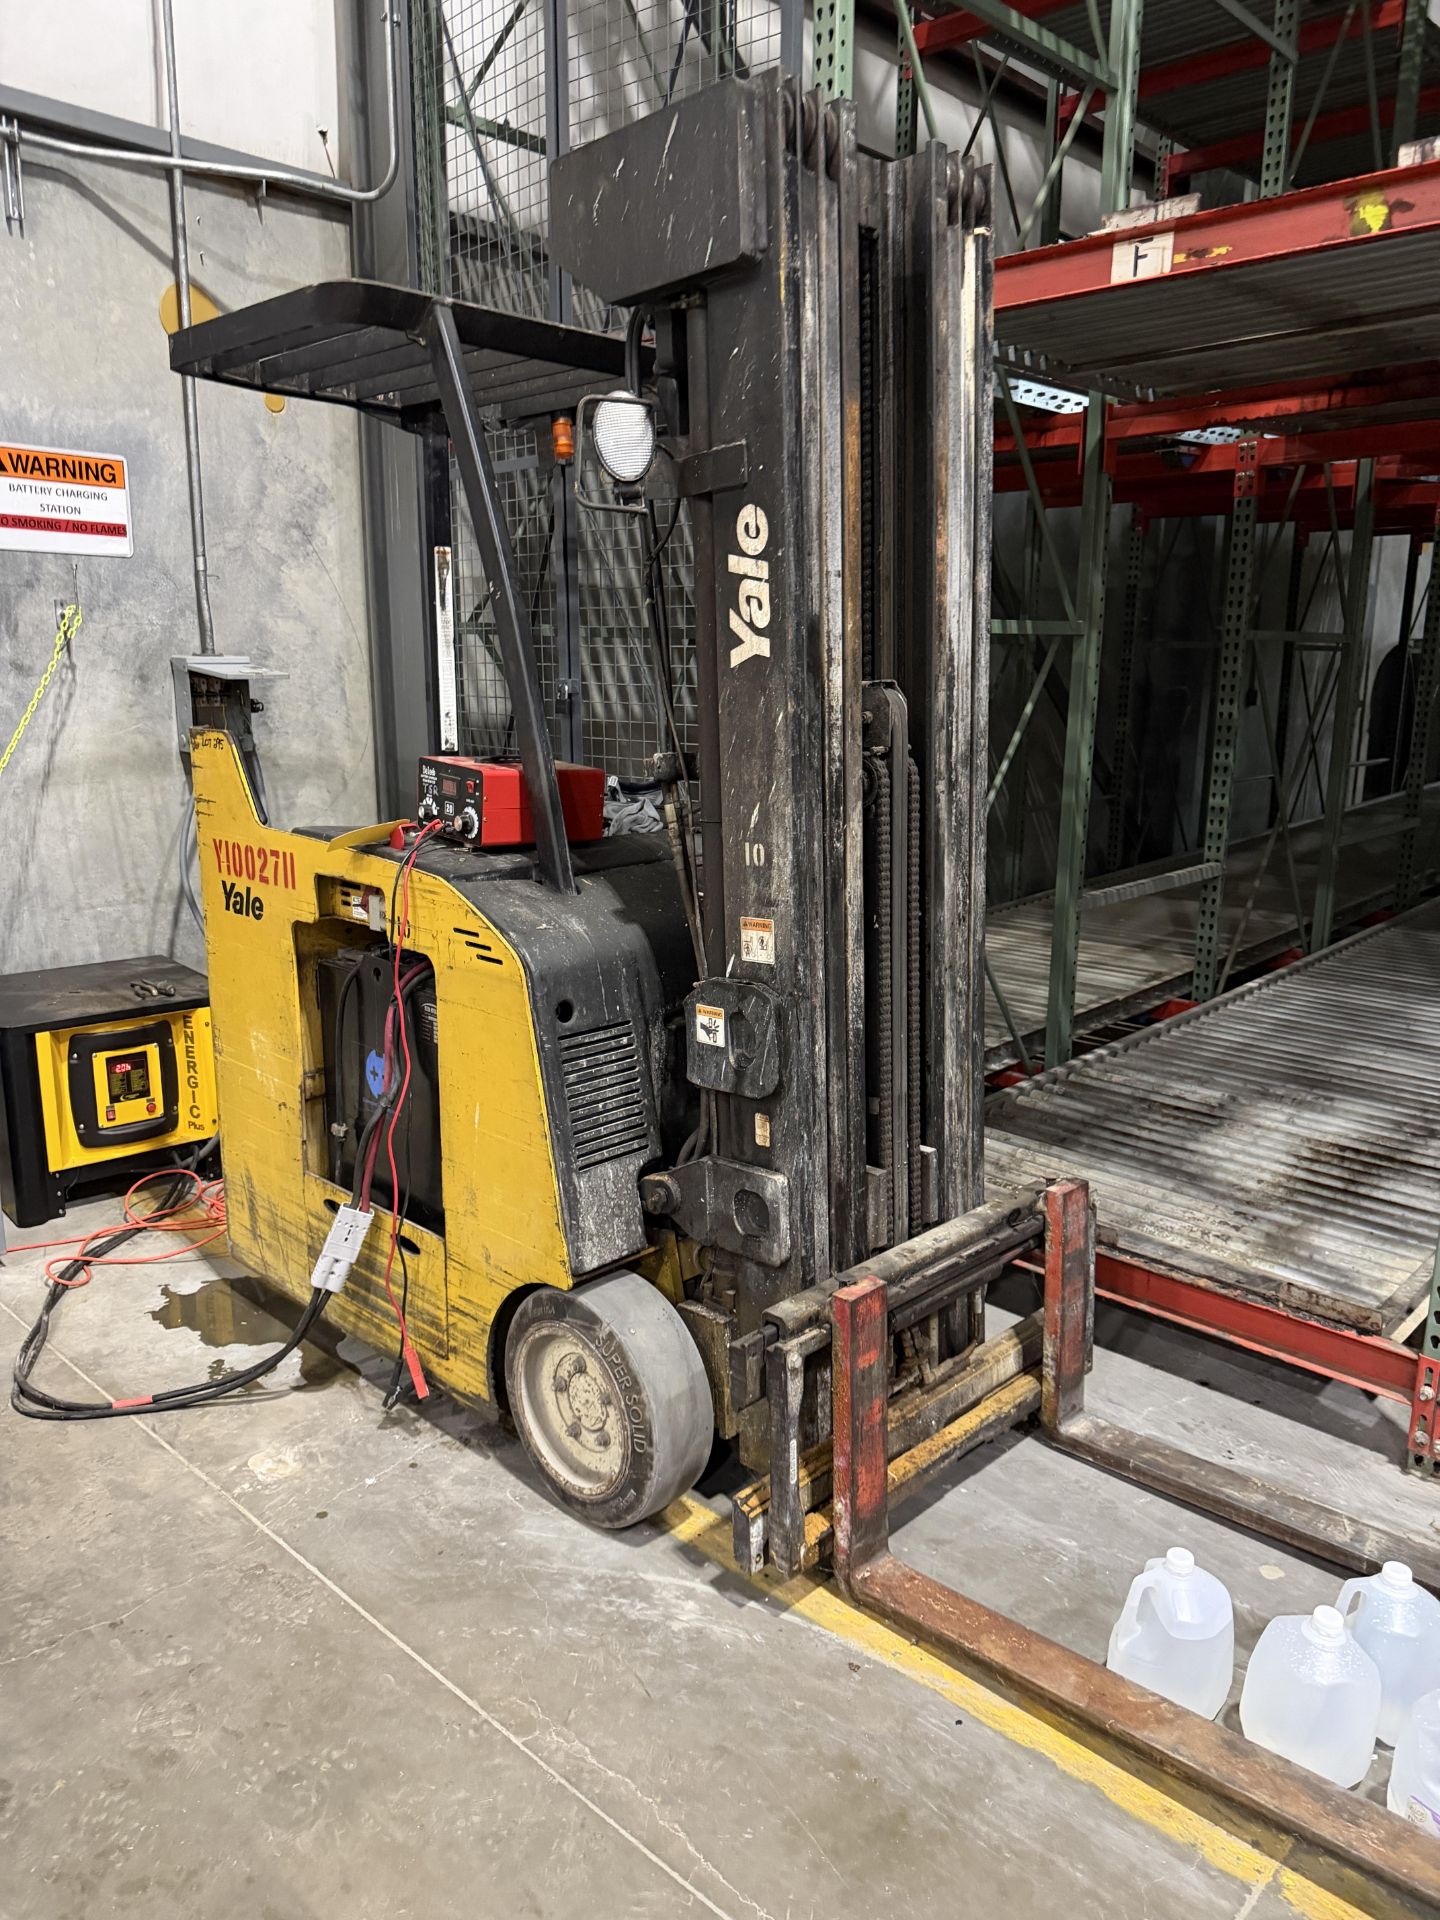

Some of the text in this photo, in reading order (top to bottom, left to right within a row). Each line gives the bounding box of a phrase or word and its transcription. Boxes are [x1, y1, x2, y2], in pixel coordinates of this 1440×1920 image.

[1131, 236, 1154, 277] F
[8, 452, 117, 484] WARNING
[8, 483, 108, 501] BATTERY CHARGING
[39, 504, 81, 515] STATION
[0, 516, 9, 526] O
[11, 517, 62, 531] SMOKING
[72, 523, 88, 532] NO
[90, 525, 127, 536] FLAMES
[728, 503, 771, 668] Yale
[212, 838, 296, 890] Y1002711
[744, 842, 765, 866] 10
[221, 880, 264, 921] Yale
[747, 922, 772, 930] WARNING
[183, 1014, 200, 1119] ENERGIC
[187, 1120, 205, 1131] Plus
[595, 1336, 632, 1390] SUPER
[625, 1394, 647, 1453] SOLID
